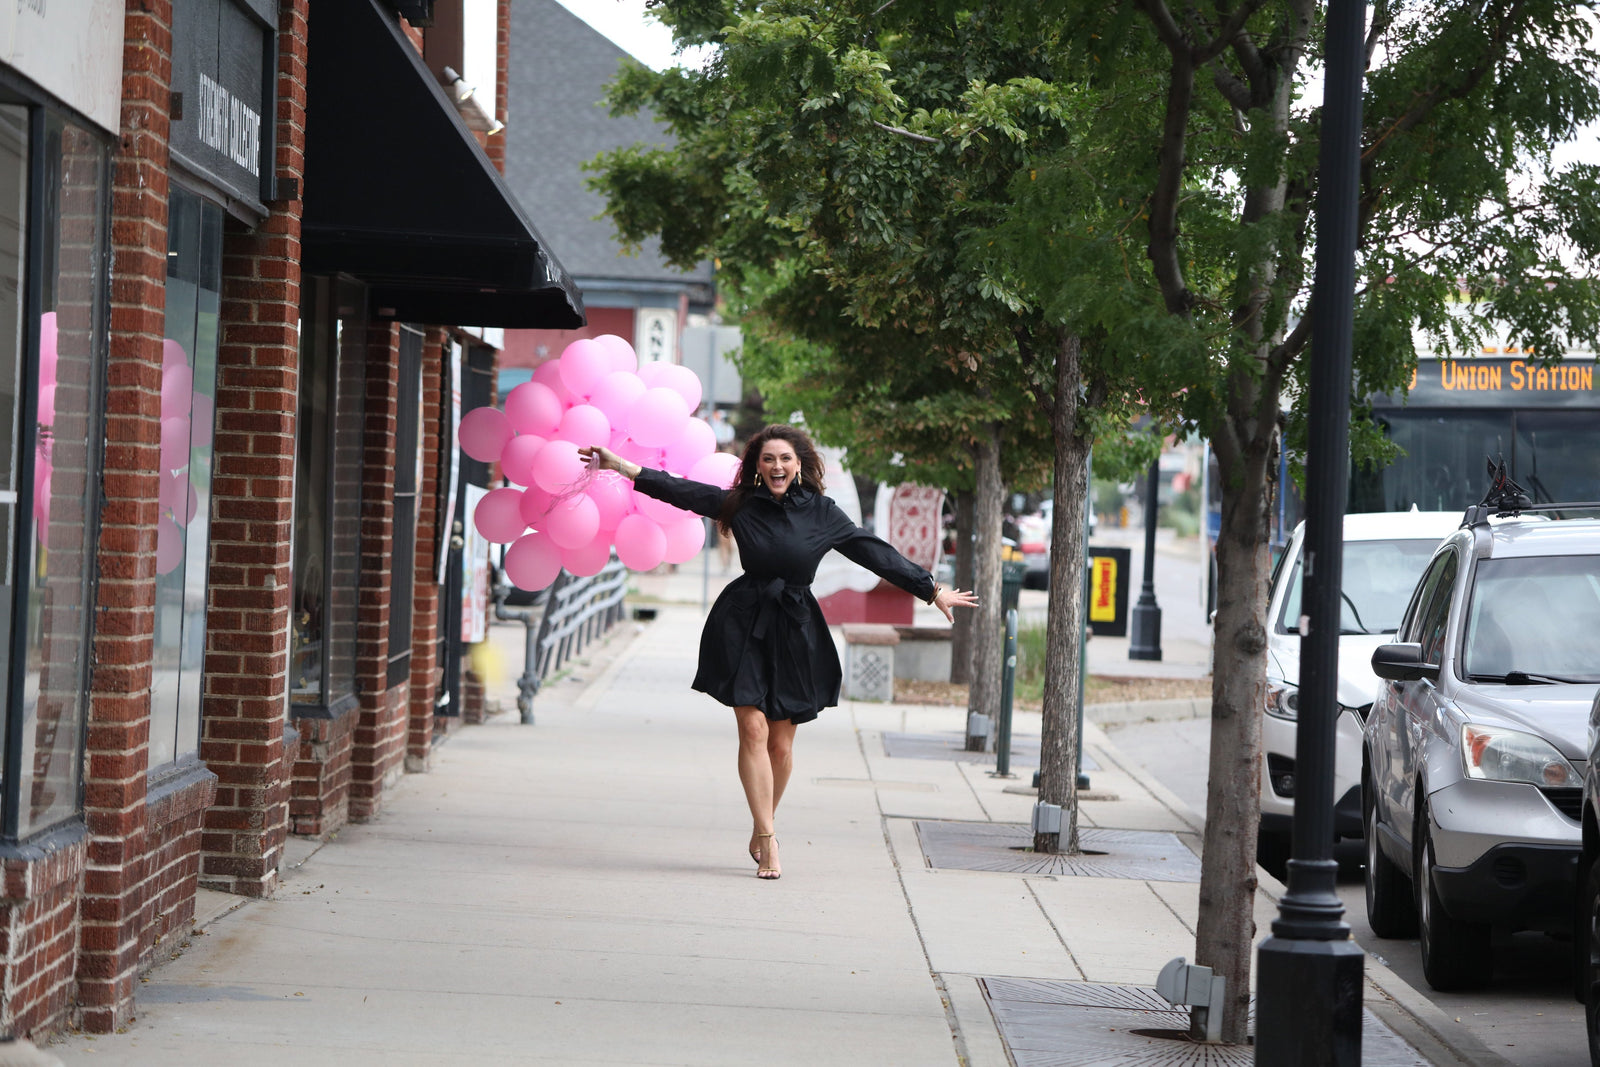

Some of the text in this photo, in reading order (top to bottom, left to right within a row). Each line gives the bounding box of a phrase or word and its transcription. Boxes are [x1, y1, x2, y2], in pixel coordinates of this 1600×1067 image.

[199, 72, 261, 178] STRENGTH COLLECTIVE
[1441, 360, 1502, 391] UNION
[1510, 360, 1593, 391] STATION
